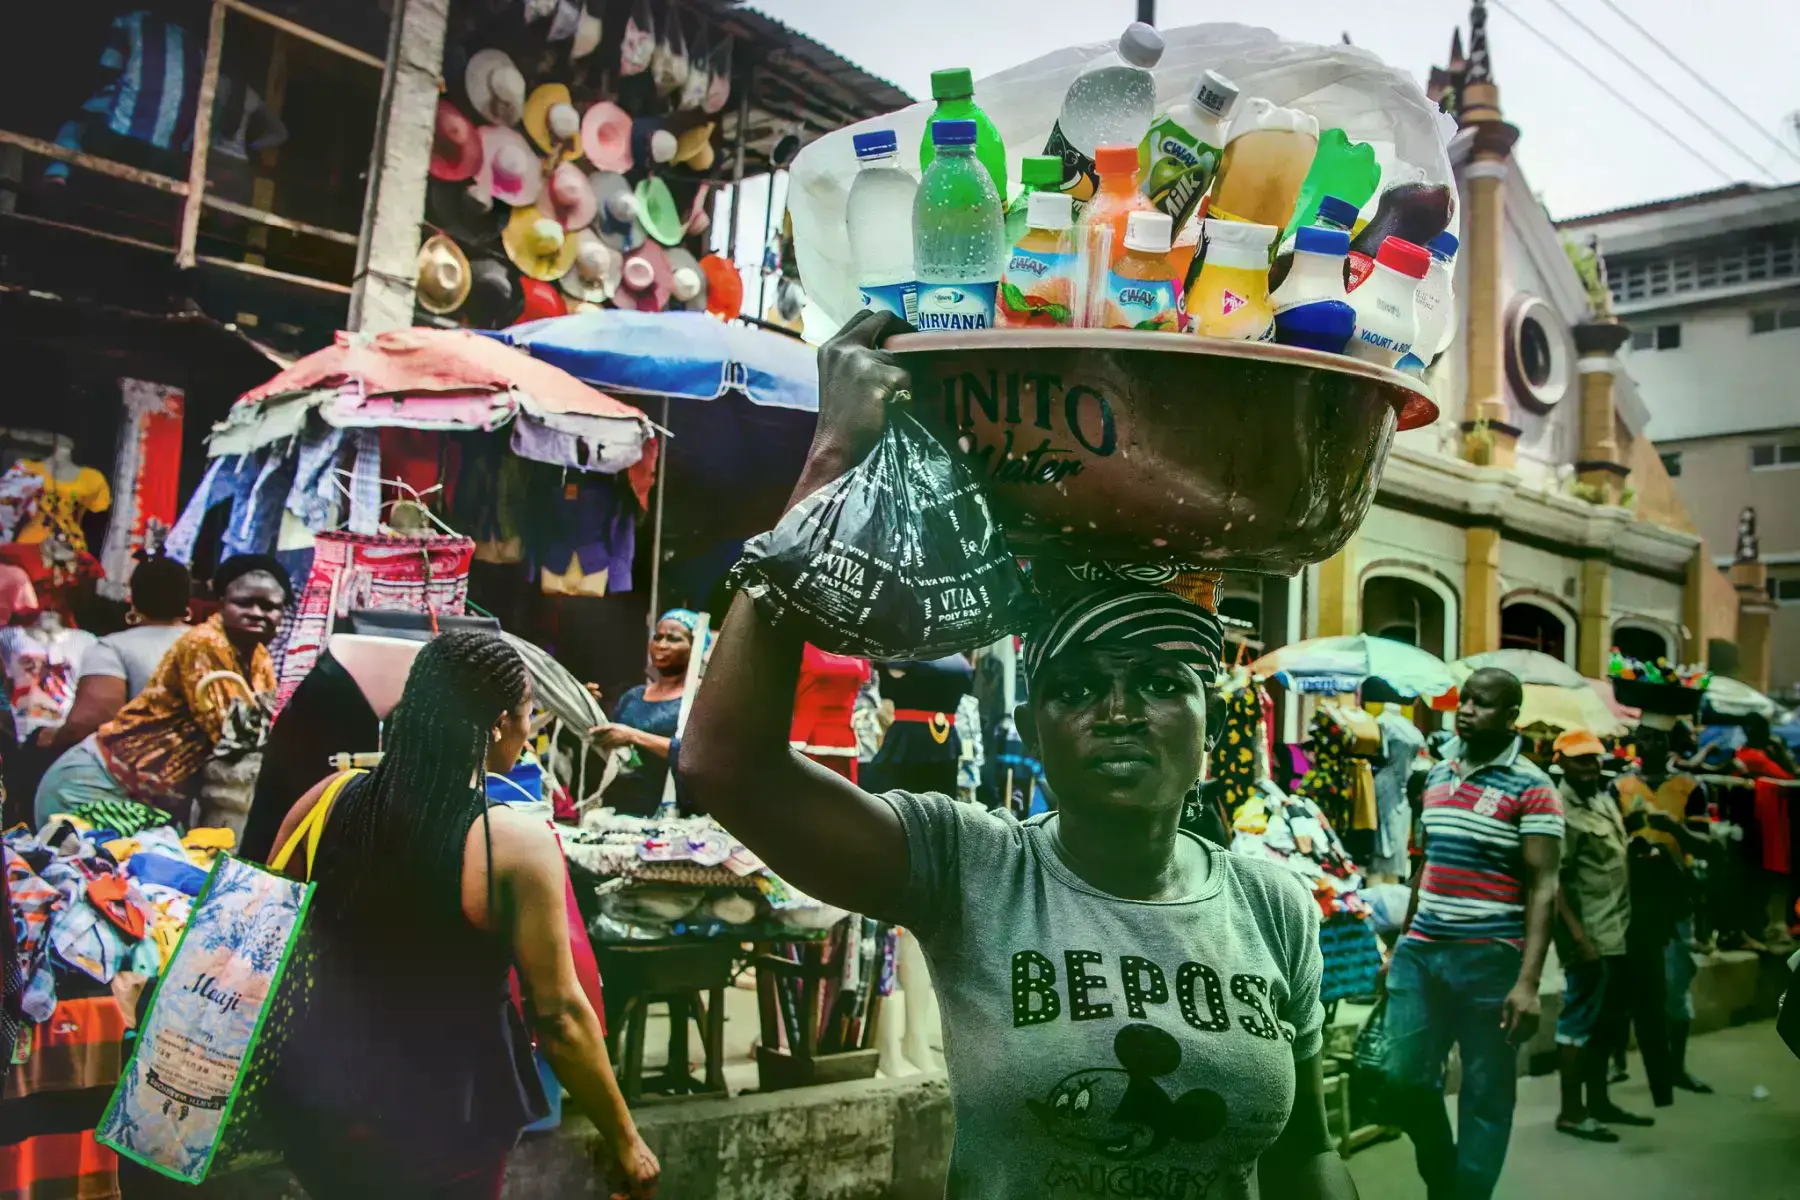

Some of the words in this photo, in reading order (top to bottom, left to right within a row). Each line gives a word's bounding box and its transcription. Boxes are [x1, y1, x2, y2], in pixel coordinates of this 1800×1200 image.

[1163, 140, 1198, 168] CWAY
[1009, 256, 1049, 275] CWAY
[1119, 290, 1155, 307] CWAY
[918, 311, 986, 331] NIRVANA
[1361, 329, 1393, 349] YAOURT
[848, 545, 869, 560] VIVA
[874, 557, 894, 572] VIVA
[822, 553, 865, 587] VIVA
[841, 583, 862, 600] BAG
[869, 580, 884, 600] VIVA
[940, 588, 978, 611] VIVA
[938, 610, 961, 622] POLY
[1011, 950, 1293, 1043] BEPOS
